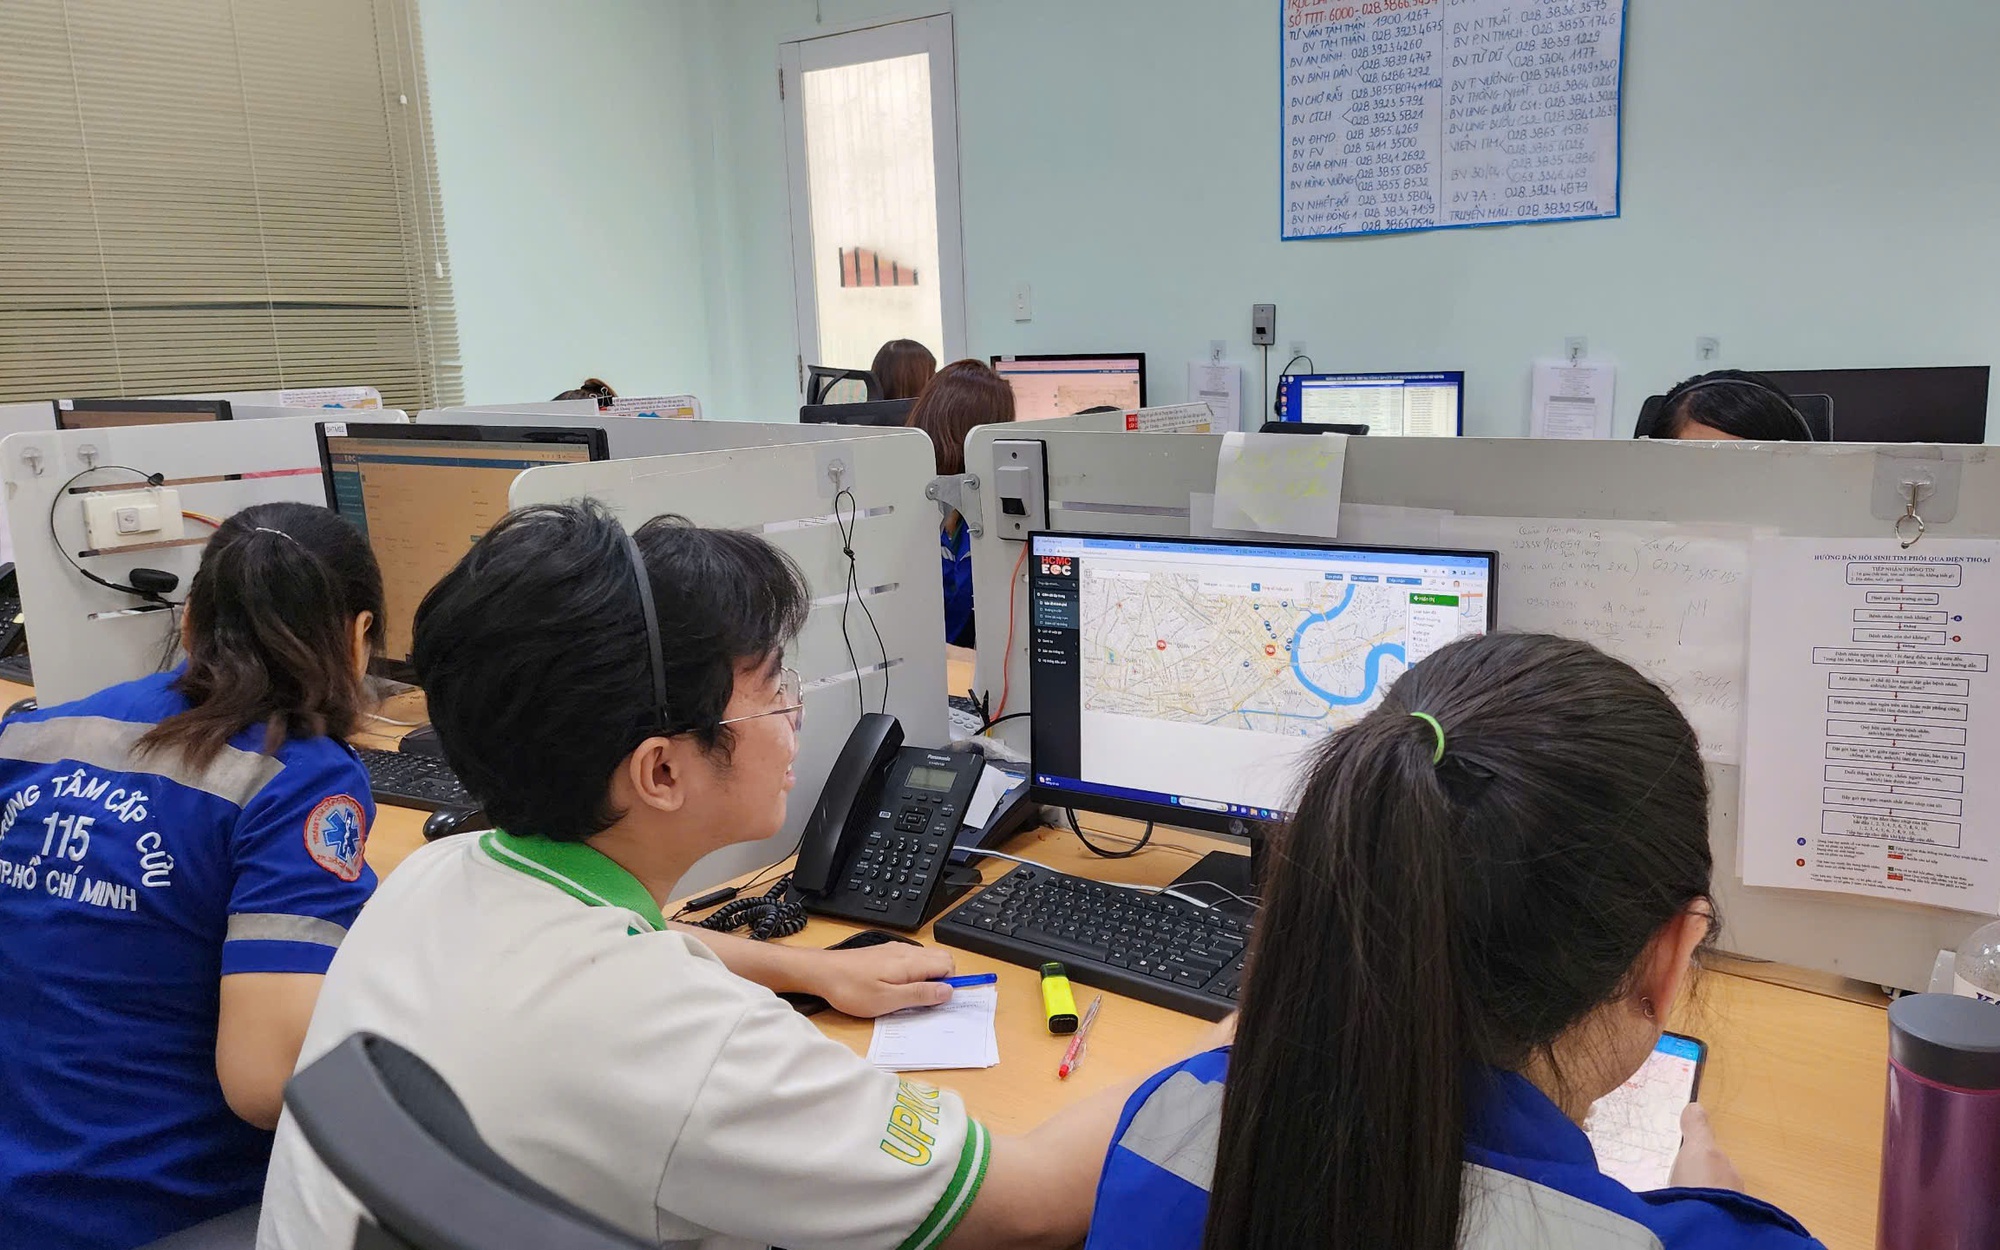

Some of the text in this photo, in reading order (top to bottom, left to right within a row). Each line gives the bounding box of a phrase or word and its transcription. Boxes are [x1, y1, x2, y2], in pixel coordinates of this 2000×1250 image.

[1454, 23, 1469, 34] BV
[1303, 41, 1316, 53] BV
[1454, 36, 1469, 48] BV
[1290, 57, 1304, 67] BV
[1452, 56, 1468, 67] BV
[1291, 75, 1305, 86] BV
[1452, 80, 1468, 92] BV
[1450, 94, 1464, 105] BV
[1450, 108, 1464, 119] BV
[1292, 114, 1305, 125] BV
[1450, 123, 1464, 134] BV
[1292, 135, 1305, 146] BV
[1292, 149, 1305, 159] BV
[1292, 162, 1305, 173] BV
[1291, 202, 1305, 212] BV
[1292, 214, 1304, 225] BV
[1041, 556, 1072, 566] HCMC
[927, 754, 951, 762] Panasonic
[52, 768, 112, 801] TÂM
[104, 788, 149, 823] CẤP
[136, 831, 175, 888] CỨU
[41, 811, 96, 862] 115
[46, 865, 84, 899] CHÍ
[79, 877, 137, 912] MINH
